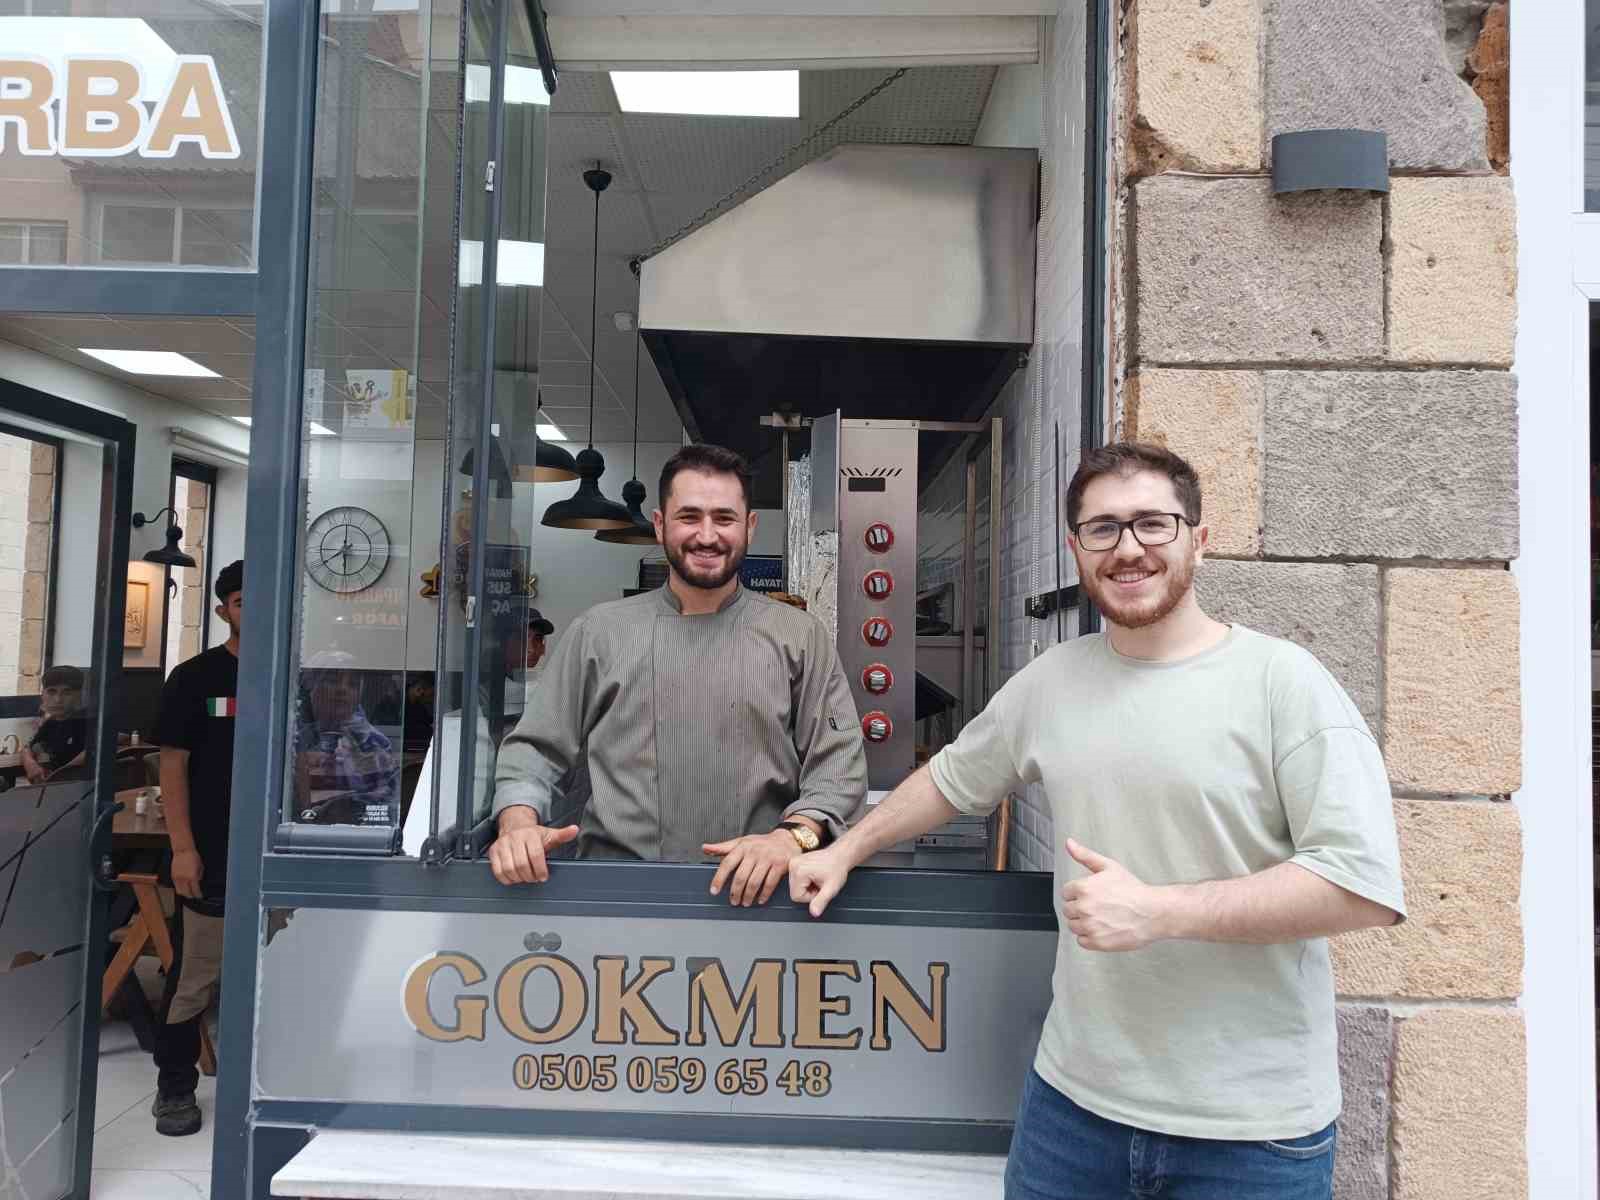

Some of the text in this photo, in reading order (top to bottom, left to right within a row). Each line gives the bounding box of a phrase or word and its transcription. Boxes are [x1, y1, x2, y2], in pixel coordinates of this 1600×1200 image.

[402, 931, 950, 1053] GÖKMEN
[512, 1053, 832, 1097] 0505 059 65 48
